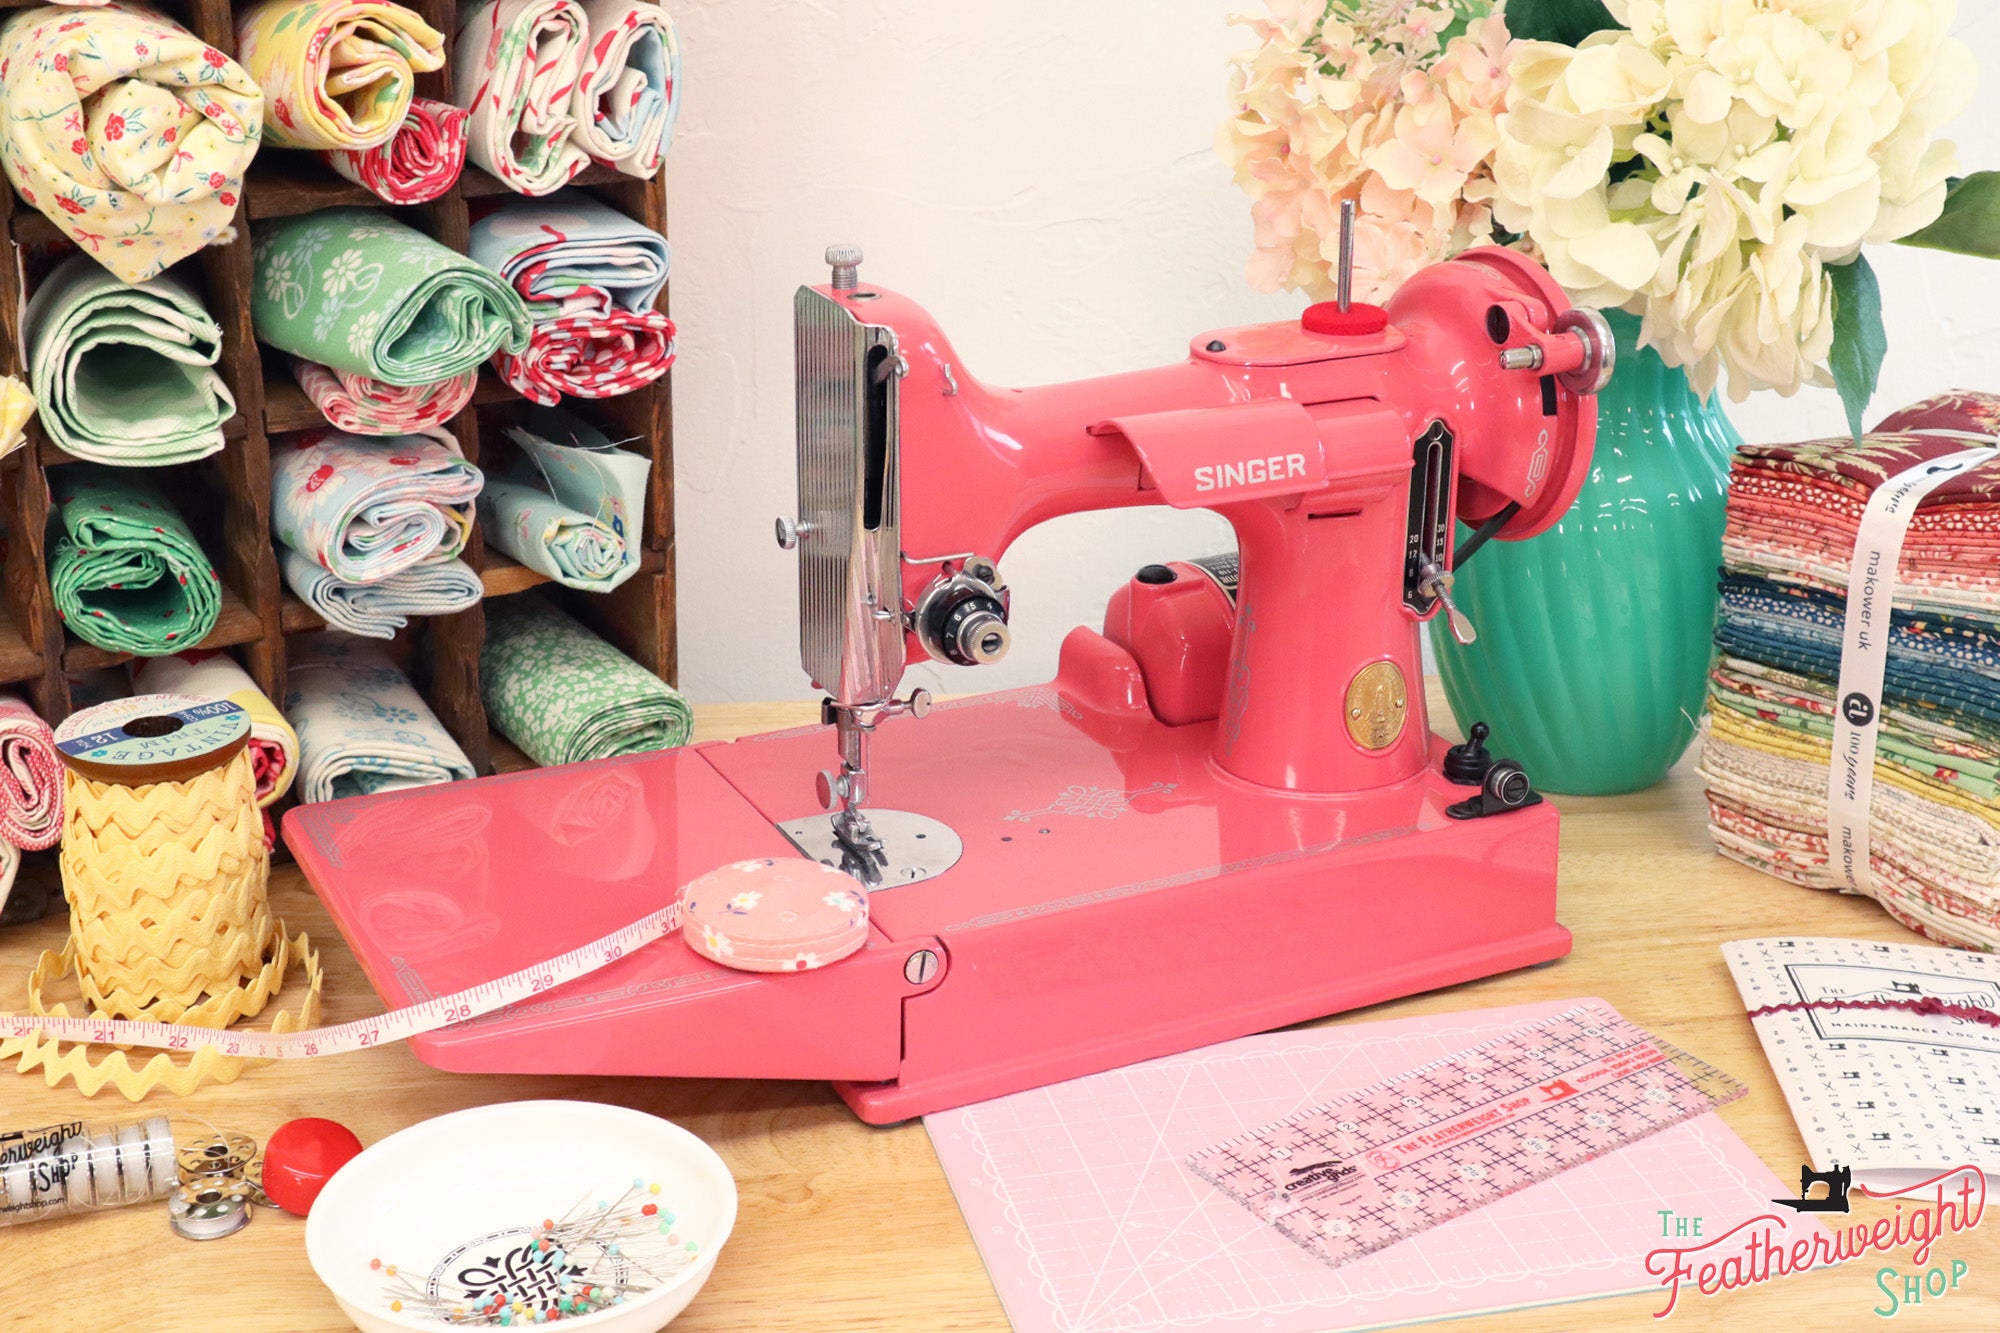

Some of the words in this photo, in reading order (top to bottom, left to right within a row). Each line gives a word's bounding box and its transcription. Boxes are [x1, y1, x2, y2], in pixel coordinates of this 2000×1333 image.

[1194, 453, 1306, 491] SINGER
[1437, 523, 1445, 533] 30
[1409, 534, 1419, 544] 20
[1436, 537, 1444, 546] 15
[1408, 549, 1418, 559] 12
[1435, 553, 1443, 562] 10
[1408, 568, 1414, 577] 8
[1407, 590, 1413, 599] 6
[1863, 551, 1880, 627] makower
[954, 614, 961, 622] 6
[1857, 628, 1873, 651] uk
[193, 701, 237, 717] 100%
[91, 734, 118, 745] 12
[112, 721, 240, 760] VINTAGE
[138, 728, 208, 749] TRIM
[1849, 731, 1862, 754] 100
[1843, 754, 1861, 800] years
[660, 917, 677, 934] 31
[603, 946, 622, 963] 30
[530, 974, 555, 992] 29
[443, 1004, 472, 1022] 28
[94, 1030, 115, 1041] 21
[358, 1030, 380, 1046] 27
[1831, 1022, 1939, 1035] MAINTENANCE
[1946, 1031, 1974, 1039] LOG
[169, 1036, 188, 1050] 22
[226, 1042, 240, 1054] 23
[303, 1043, 319, 1056] 26
[1407, 1098, 1418, 1106] 3
[1342, 1123, 1353, 1131] 2
[1393, 1140, 1421, 1154] THE
[1418, 1108, 1503, 1144] FEATHERWEIGHT
[1499, 1097, 1531, 1113] SHOP
[38, 1153, 79, 1192] SHOP
[1284, 1167, 1334, 1191] creative
